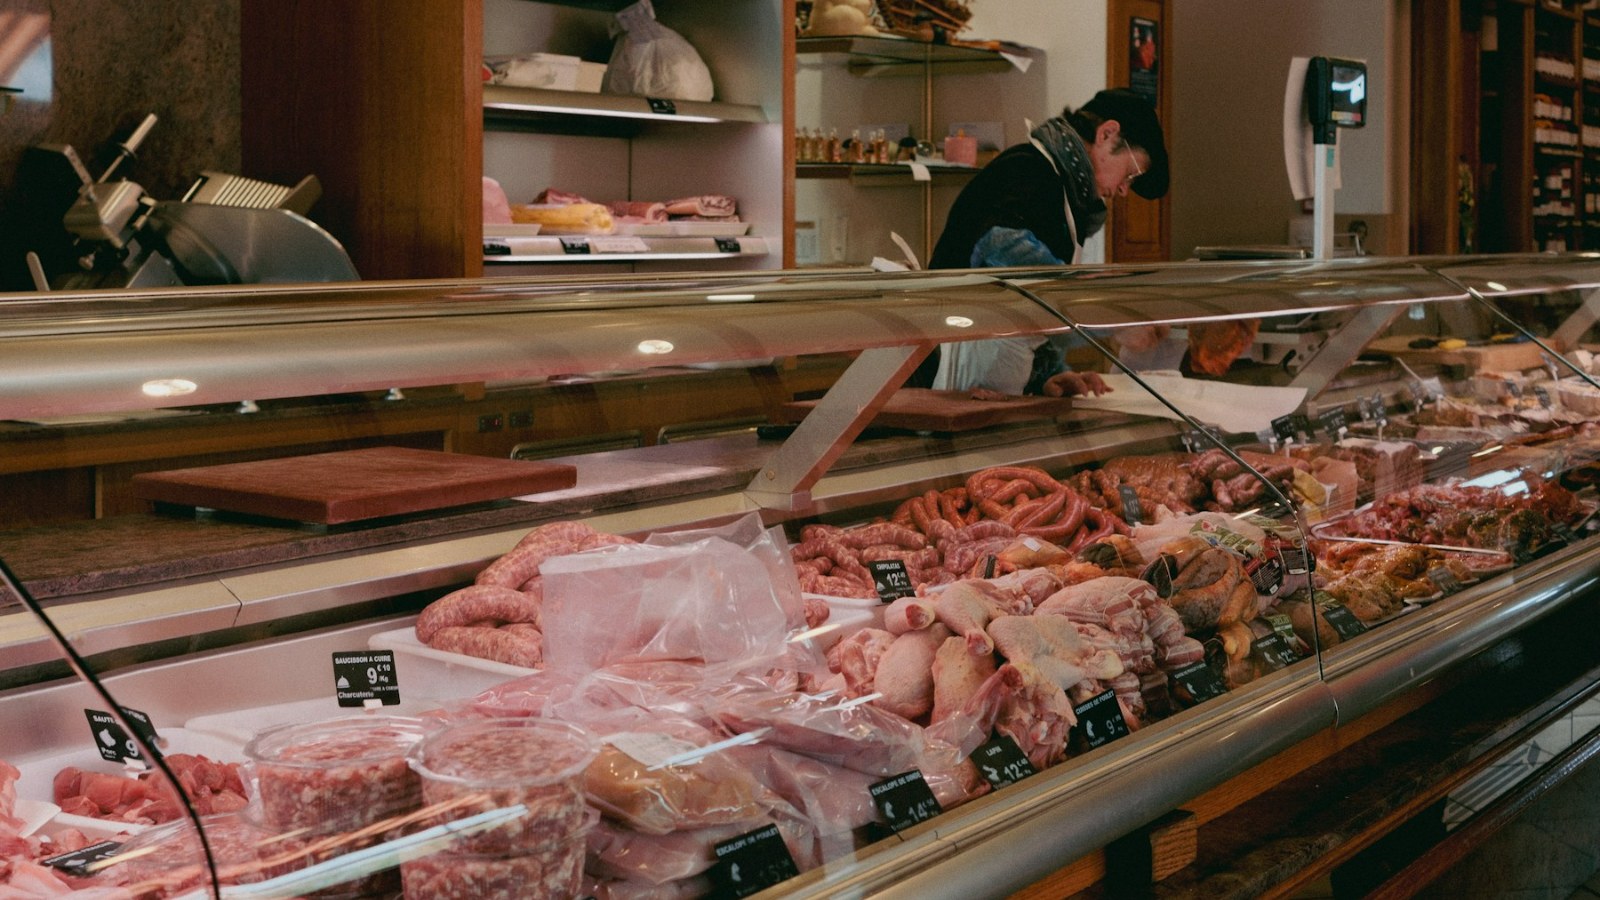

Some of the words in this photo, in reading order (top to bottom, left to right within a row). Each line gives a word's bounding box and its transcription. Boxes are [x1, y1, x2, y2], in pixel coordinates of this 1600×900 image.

[876, 563, 900, 571] CHIPOLATAS
[886, 573, 900, 587] 12
[335, 656, 368, 665] SAUCISSON
[367, 667, 378, 685] 9
[338, 691, 374, 699] Charcuterie
[1099, 690, 1114, 702] POULET
[1106, 720, 1115, 735] 9
[101, 747, 116, 755] Porc
[125, 739, 138, 757] 9
[985, 745, 1002, 756] LAPIN
[1004, 763, 1024, 780] 12
[871, 780, 899, 796] ESCALOPE
[908, 802, 928, 821] 14
[716, 838, 747, 857] ESCALOPE
[756, 827, 779, 841] POULET
